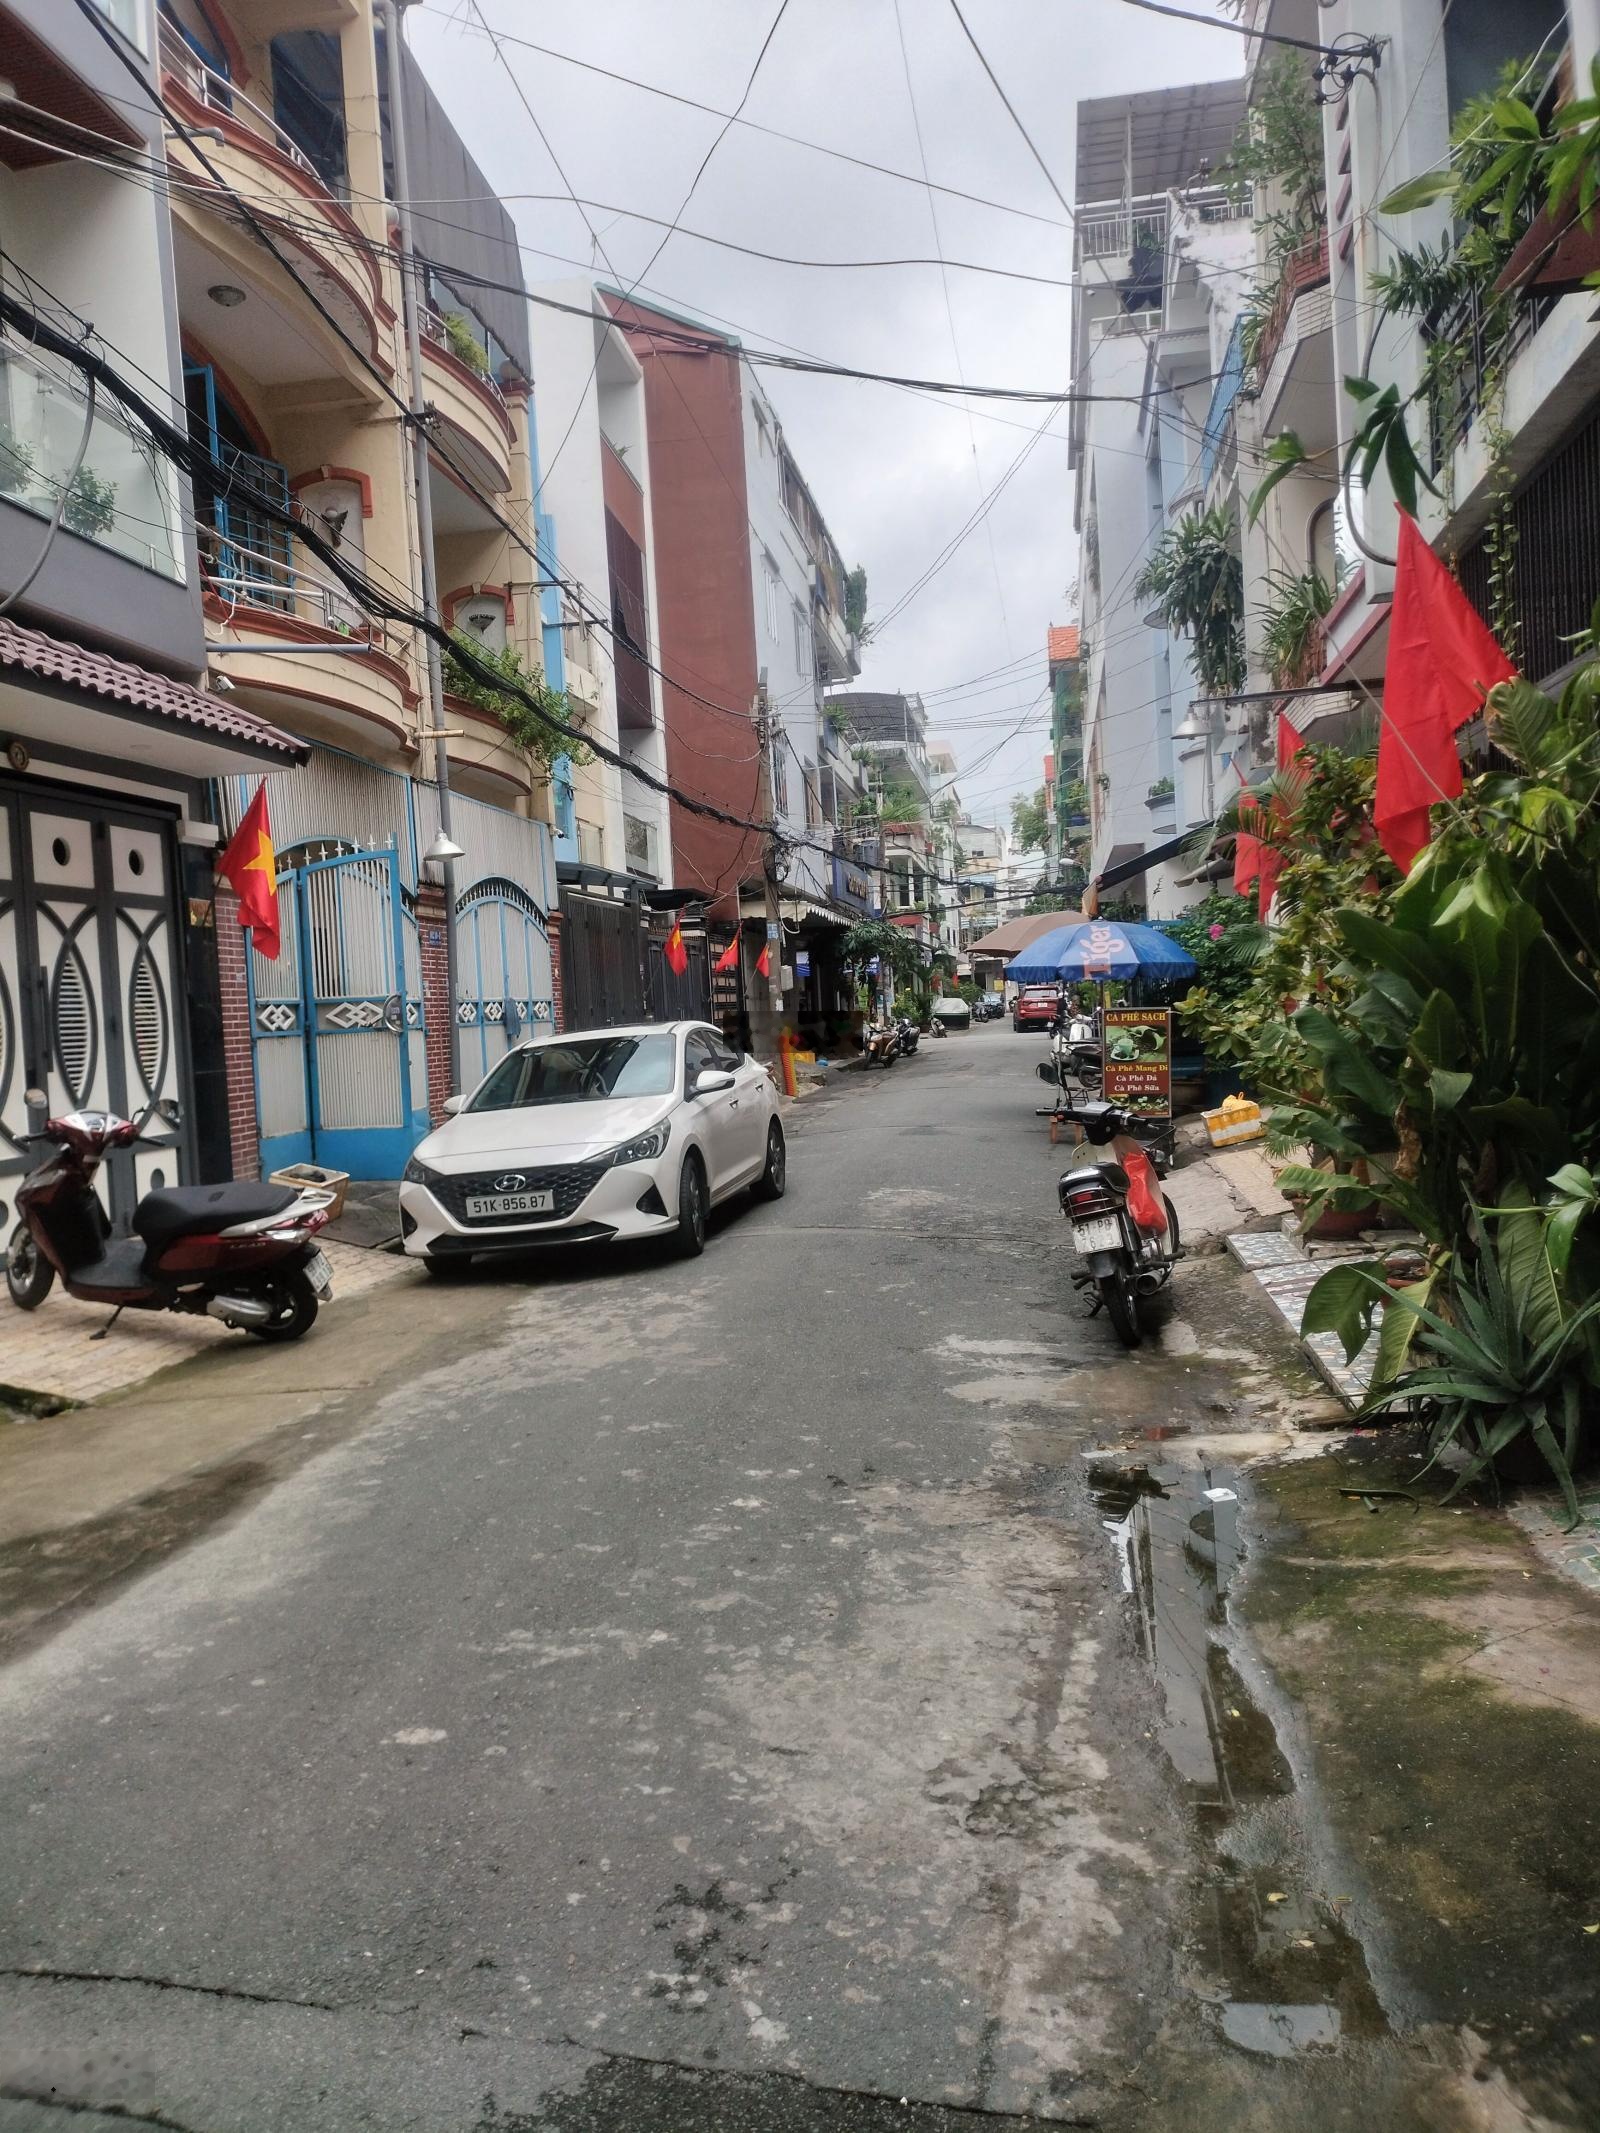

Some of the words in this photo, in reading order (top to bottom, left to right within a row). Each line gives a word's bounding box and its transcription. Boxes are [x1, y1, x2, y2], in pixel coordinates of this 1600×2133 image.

[1135, 1064, 1158, 1073] Mang
[1128, 1074, 1144, 1082] Phê
[1127, 1084, 1142, 1092] Phê
